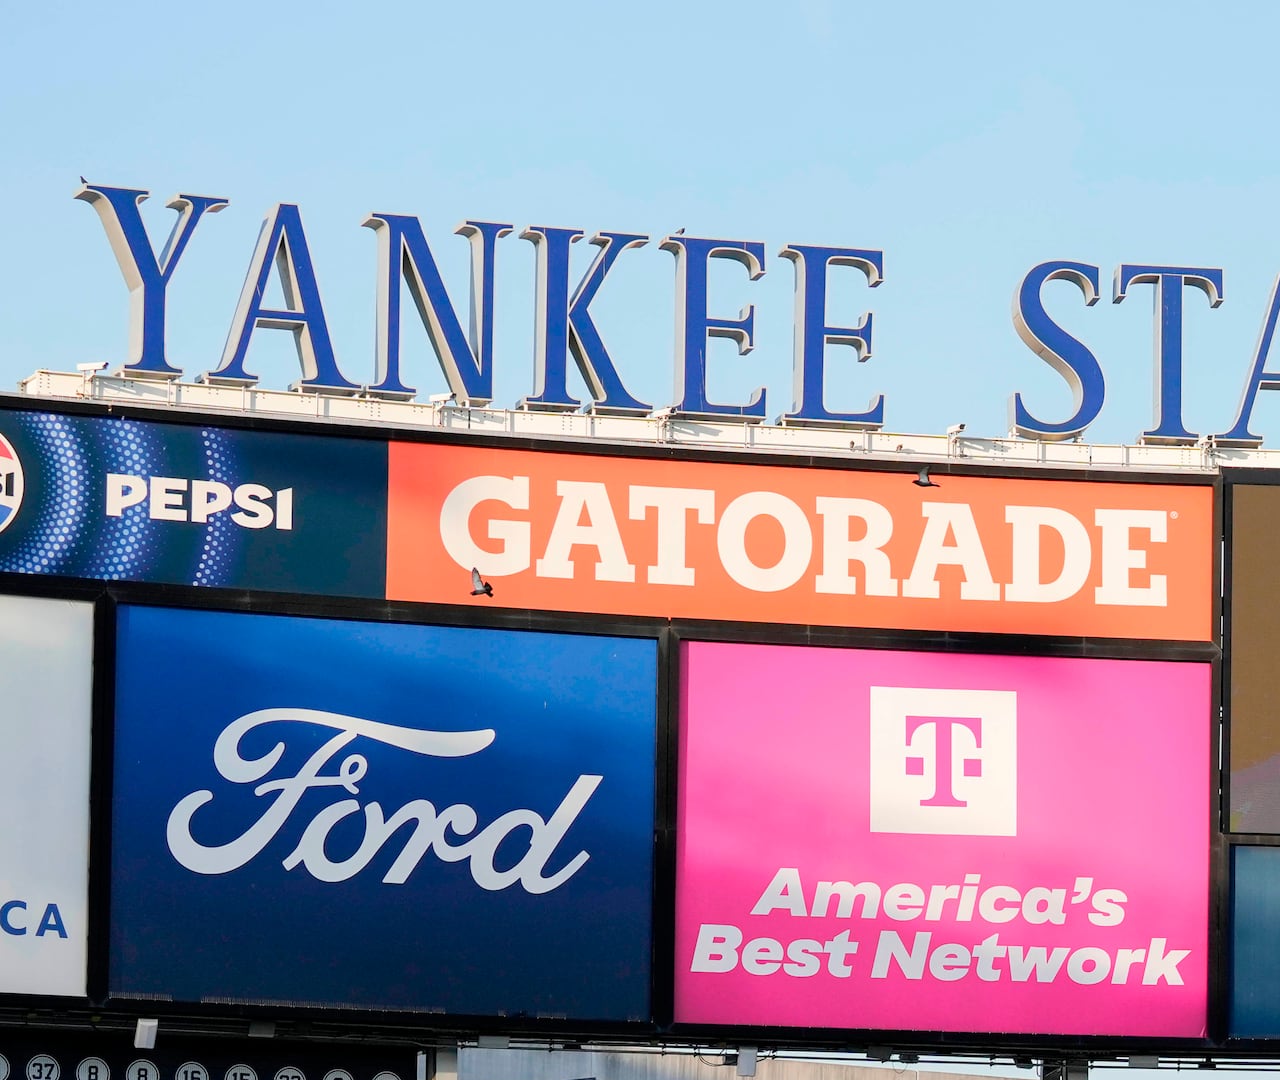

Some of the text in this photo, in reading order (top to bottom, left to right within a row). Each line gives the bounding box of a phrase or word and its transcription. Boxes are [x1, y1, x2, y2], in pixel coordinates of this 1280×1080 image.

[75, 183, 886, 426] YANKEE
[106, 473, 293, 531] PEPSI
[440, 475, 1167, 607] GATORADE
[166, 708, 590, 895] Ford
[751, 867, 1128, 928] America's
[690, 923, 1192, 987] Best Network
[32, 1063, 55, 1080] 37
